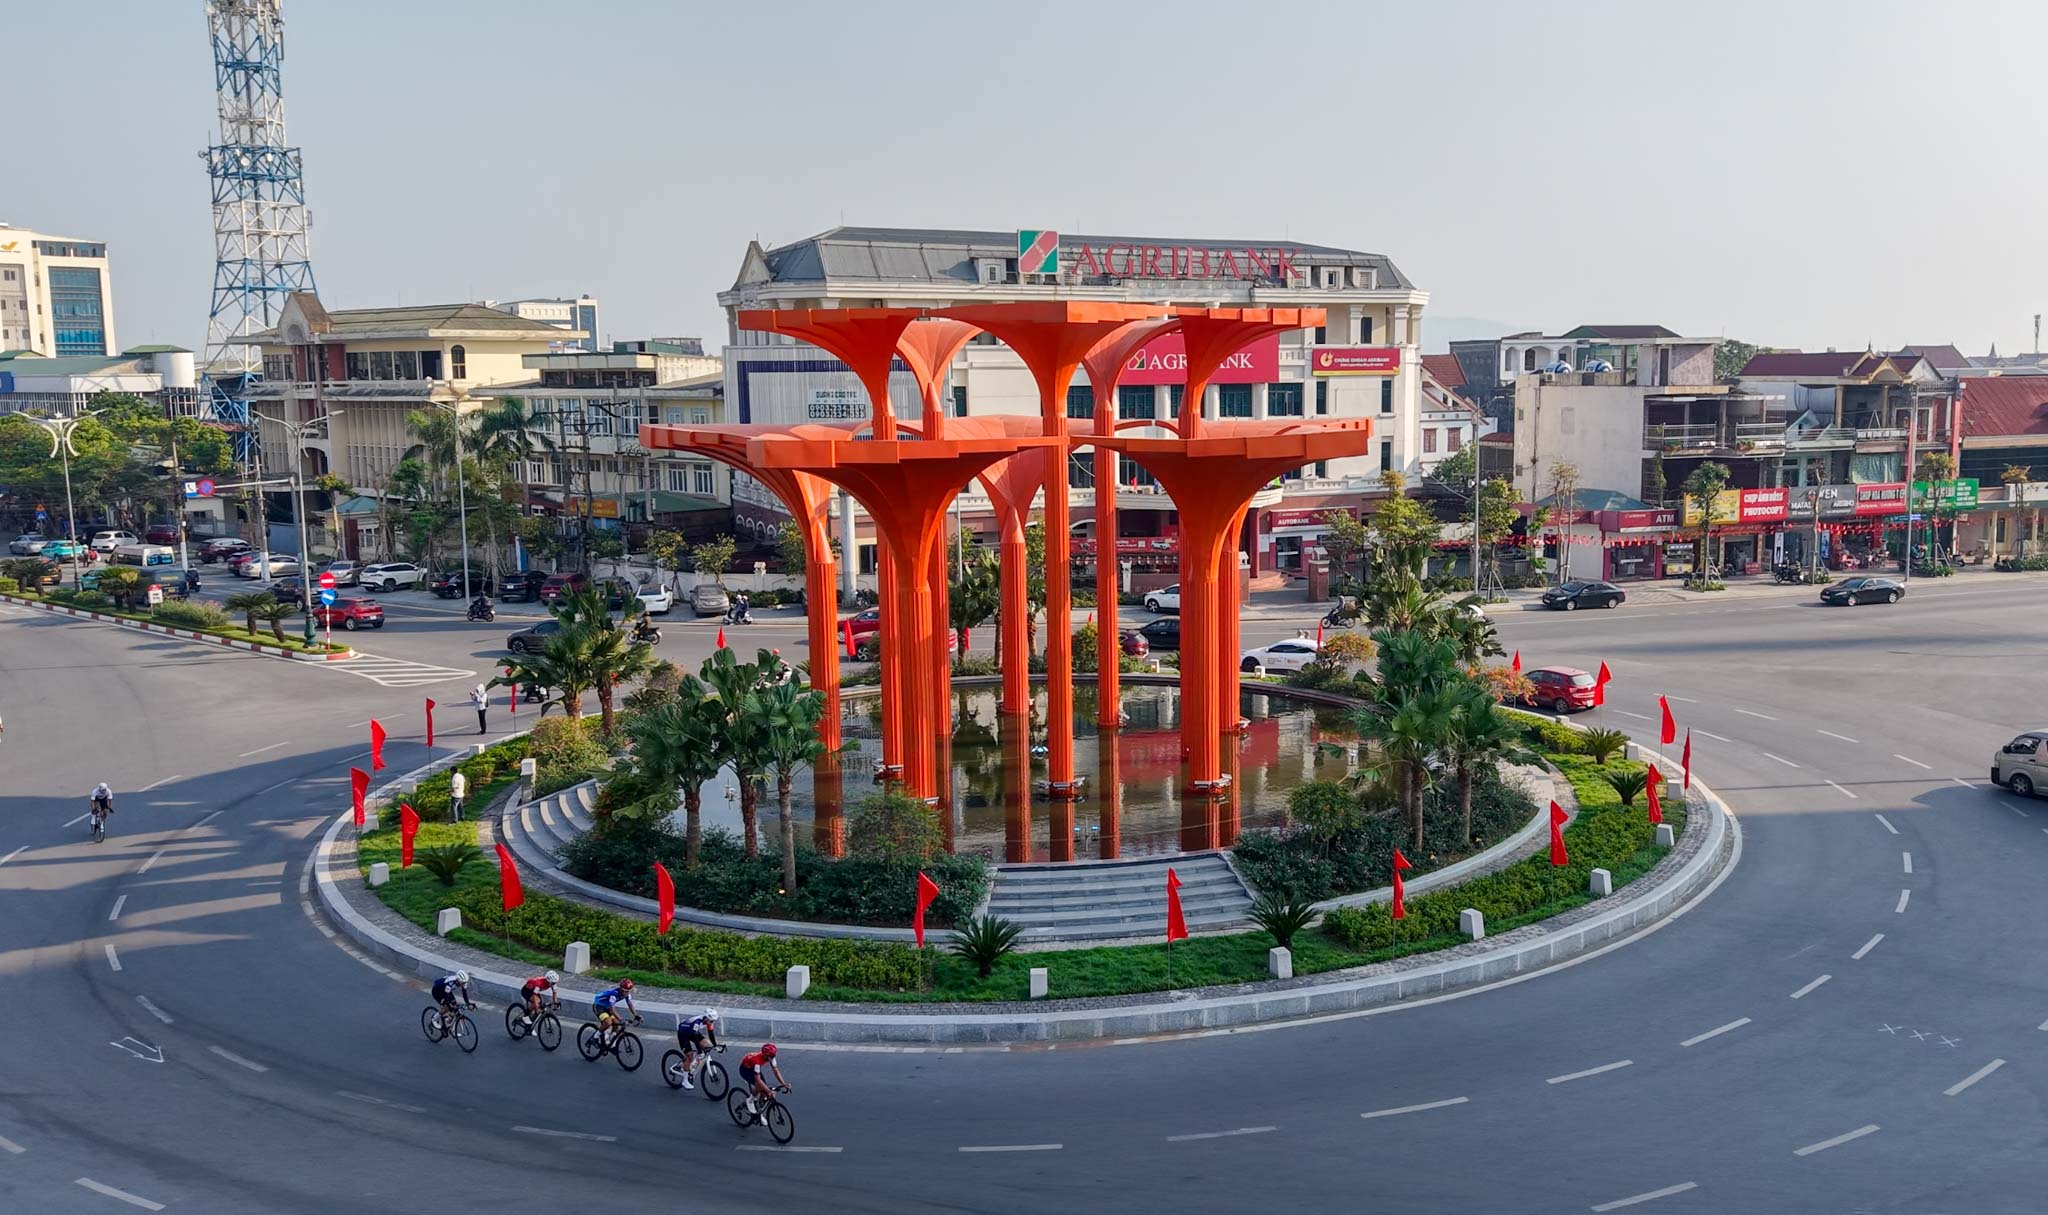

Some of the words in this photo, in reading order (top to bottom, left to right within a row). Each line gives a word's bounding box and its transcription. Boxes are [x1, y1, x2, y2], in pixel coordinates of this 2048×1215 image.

[1072, 242, 1304, 280] AGRIBANK
[1148, 353, 1255, 370] AGRNK
[1744, 505, 1785, 517] PHOTOCOPY
[1655, 514, 1675, 523] ATM
